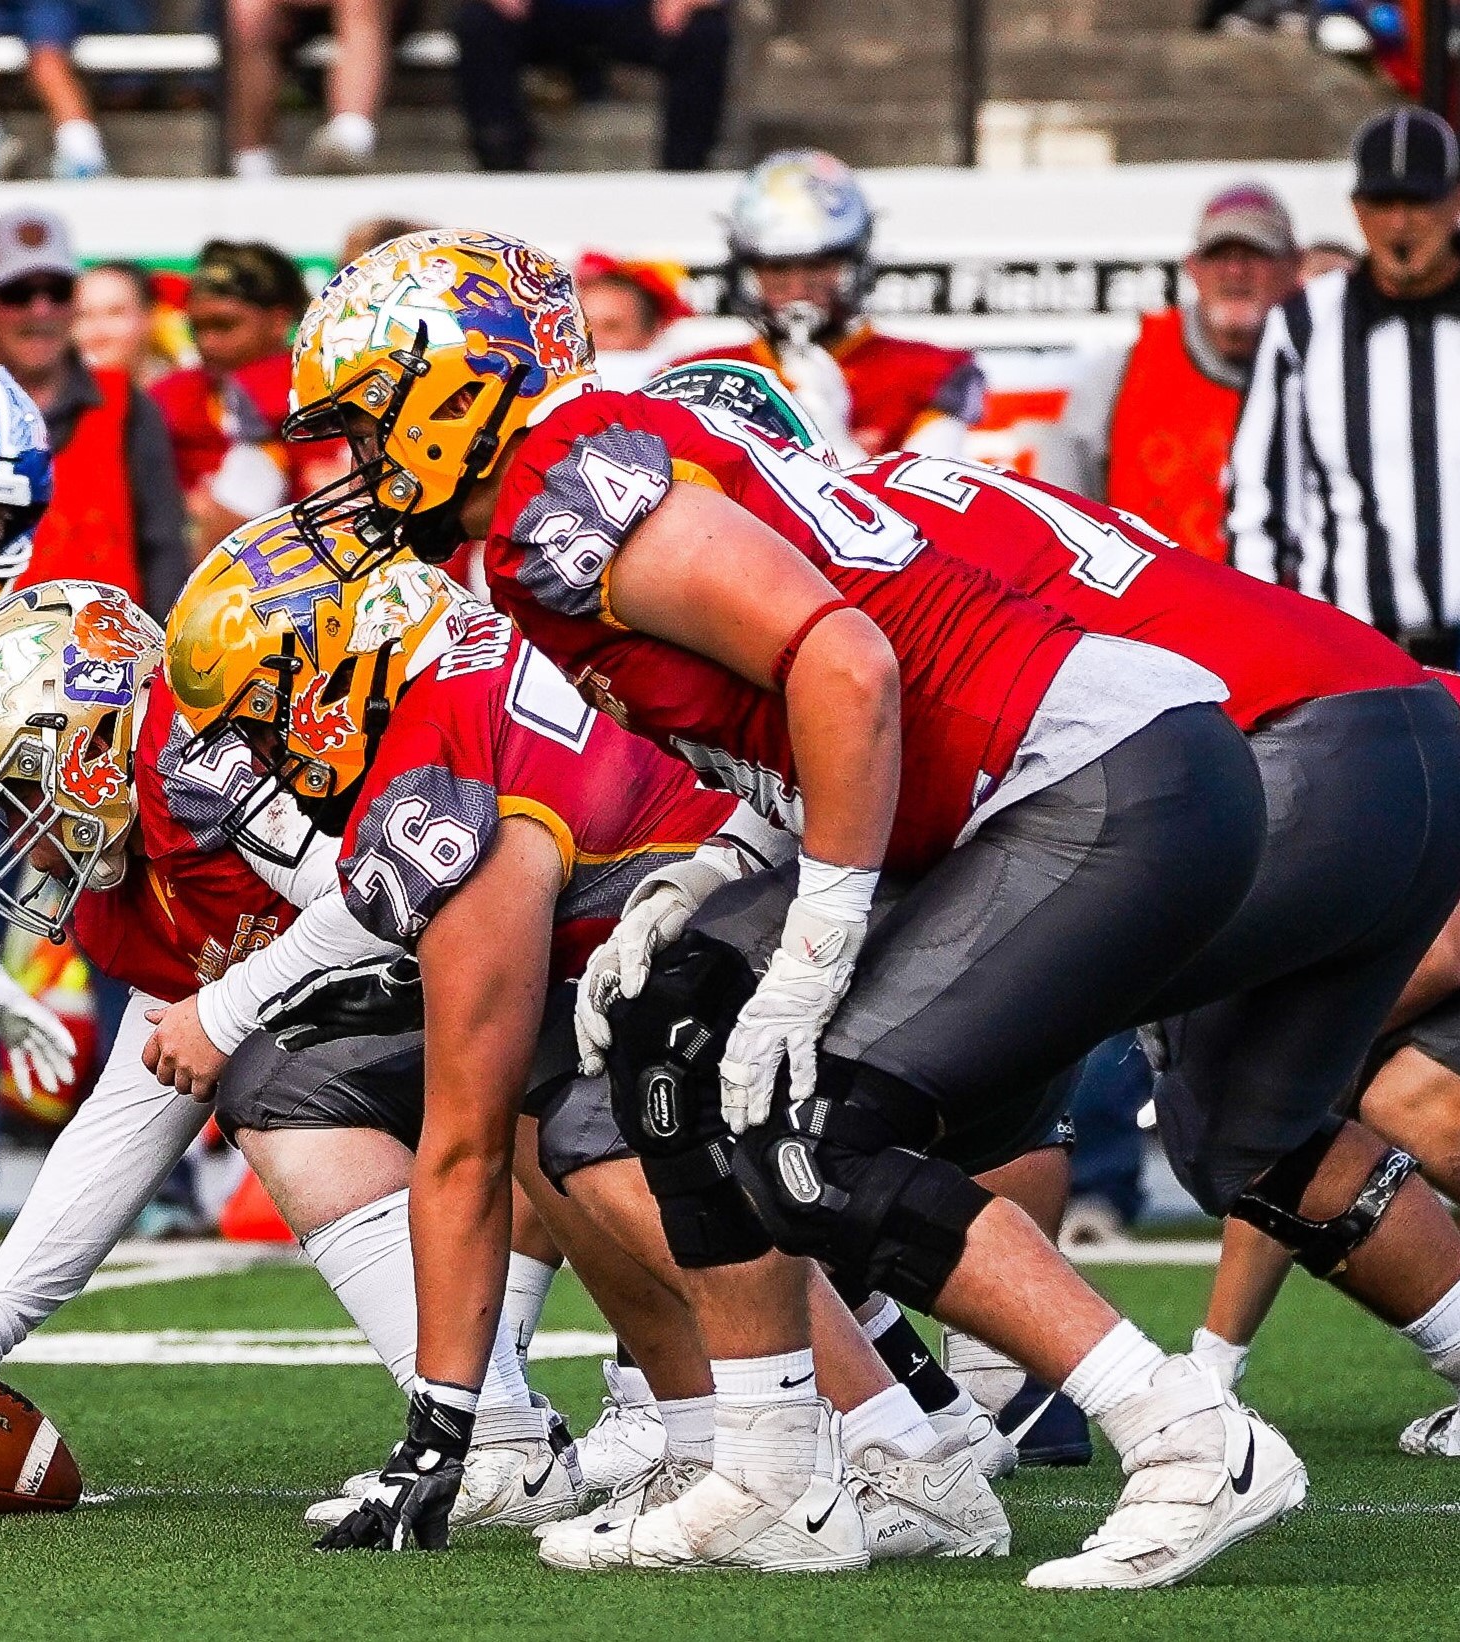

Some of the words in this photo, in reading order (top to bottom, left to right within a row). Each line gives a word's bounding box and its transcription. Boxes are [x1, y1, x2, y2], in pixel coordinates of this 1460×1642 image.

[530, 447, 670, 591] 64
[883, 454, 1180, 599] 7
[348, 794, 480, 938] 76
[25, 1461, 47, 1494] WEST
[876, 1518, 919, 1543] ALPHA
